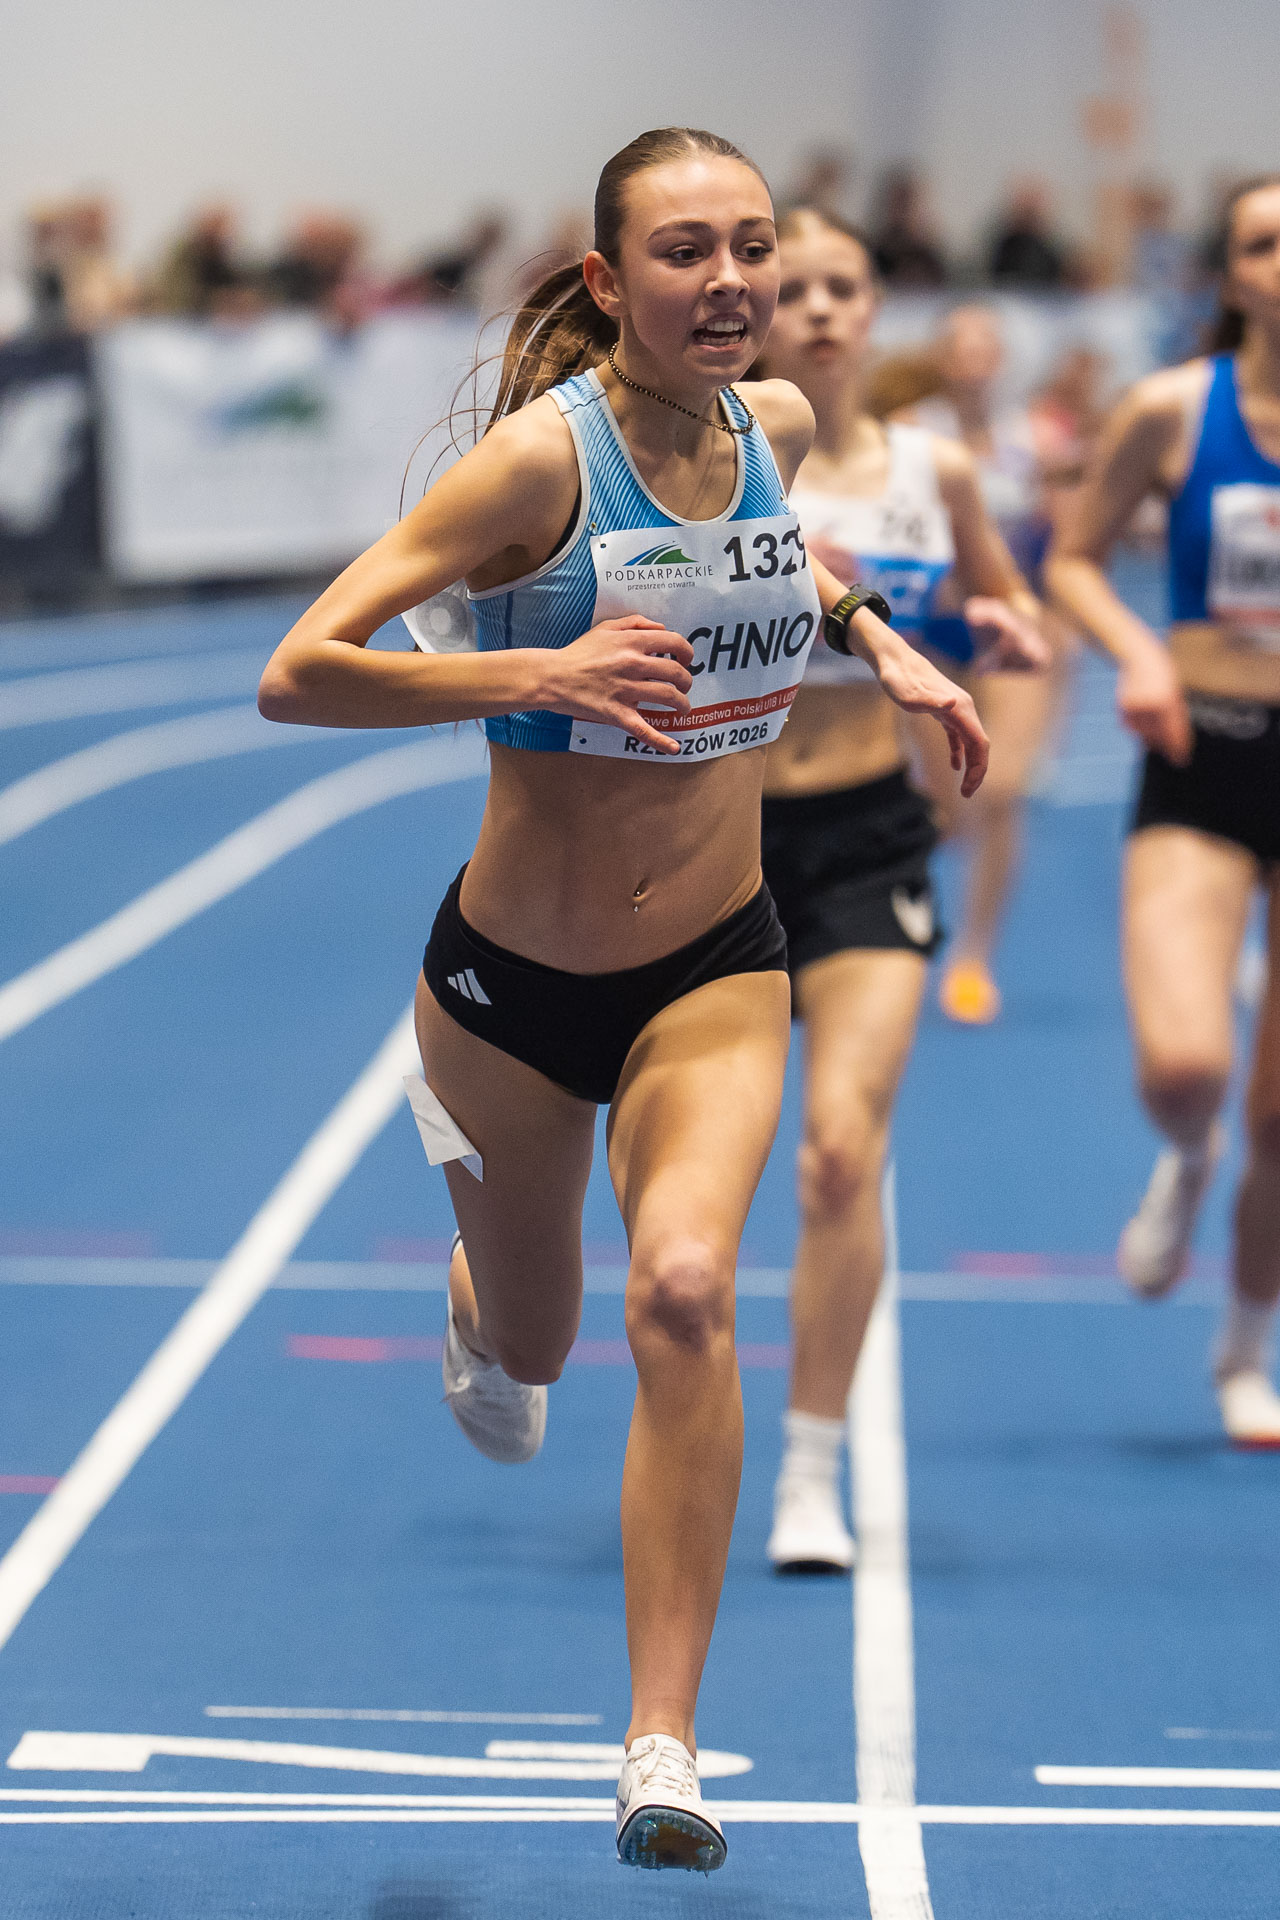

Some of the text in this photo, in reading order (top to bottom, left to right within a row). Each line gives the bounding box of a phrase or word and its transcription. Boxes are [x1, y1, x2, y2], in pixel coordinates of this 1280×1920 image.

[605, 565, 714, 582] PODKARPACKIE
[627, 581, 696, 591] przestrzeń otwarta
[655, 611, 814, 676] CHNIO
[643, 717, 670, 727] owe
[672, 708, 731, 727] Mistrzostwa
[733, 700, 764, 716] Polski
[764, 696, 777, 710] U18
[624, 721, 769, 756] RZZÓW 2026
